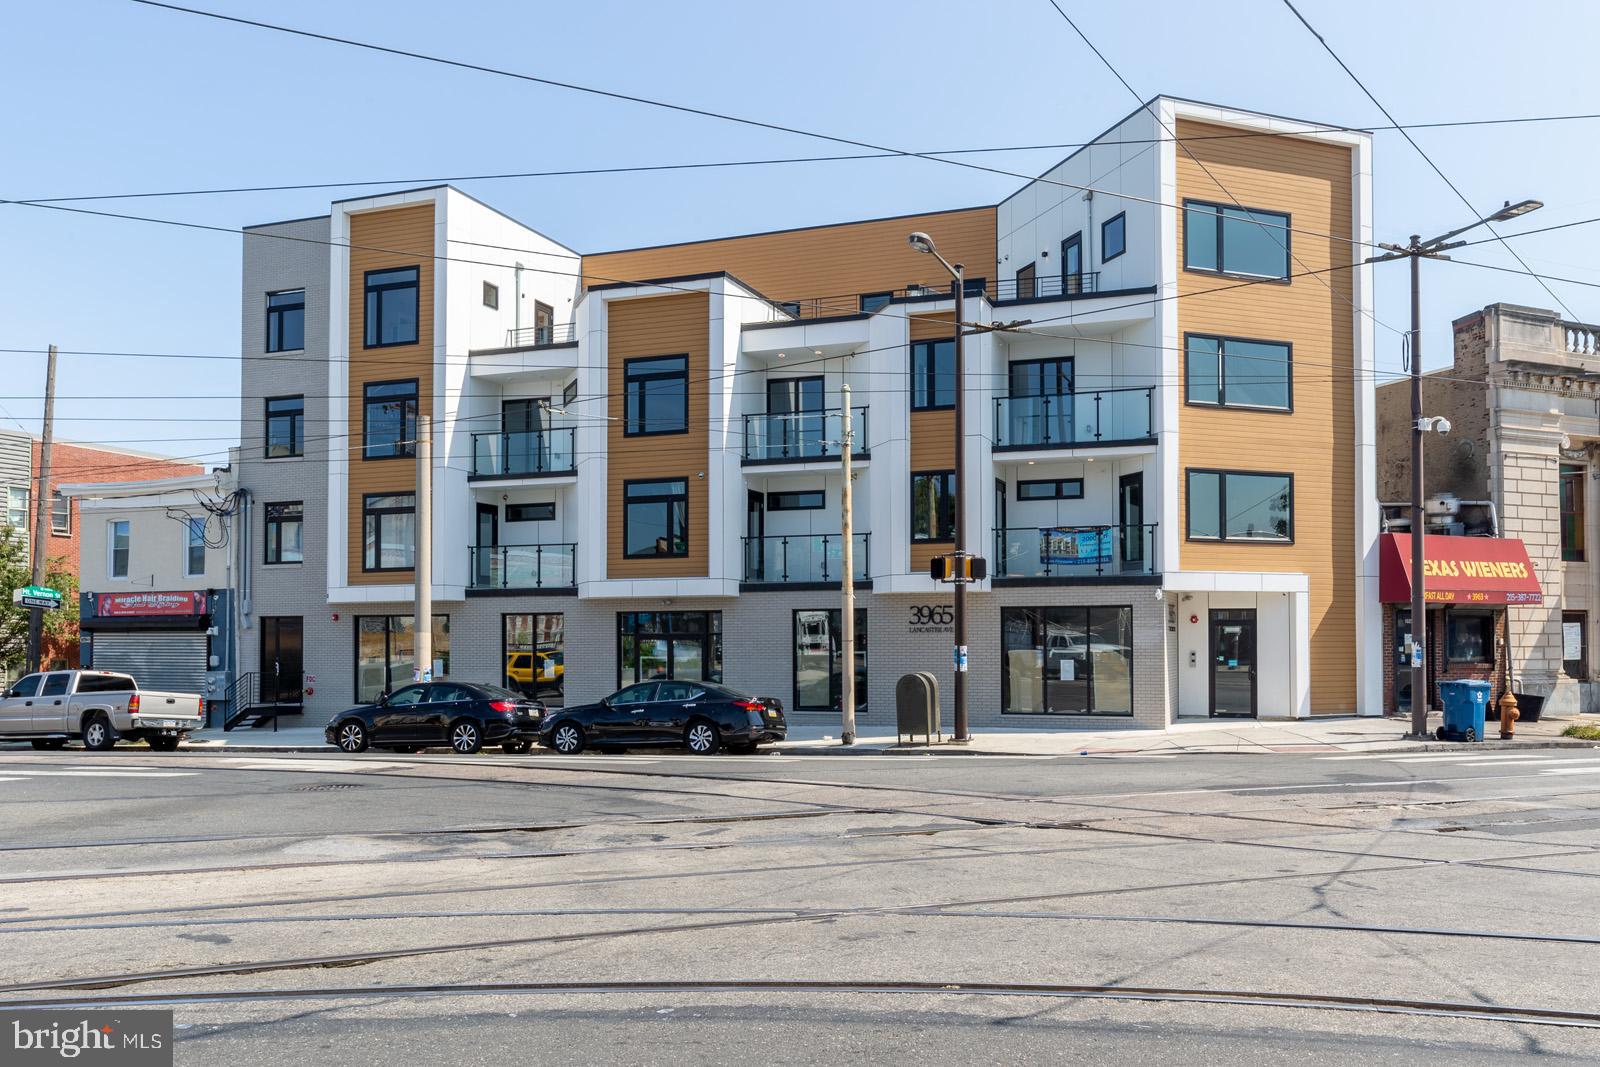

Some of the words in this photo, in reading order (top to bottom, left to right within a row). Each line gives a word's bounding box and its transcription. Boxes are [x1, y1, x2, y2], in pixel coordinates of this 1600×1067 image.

[1409, 559, 1460, 577] EXAS
[1460, 561, 1529, 579] WIENERS
[32, 590, 54, 598] Vernon
[142, 593, 158, 603] Hair
[158, 594, 189, 603] Braiding
[25, 597, 38, 605] ONE
[909, 605, 954, 625] 3965
